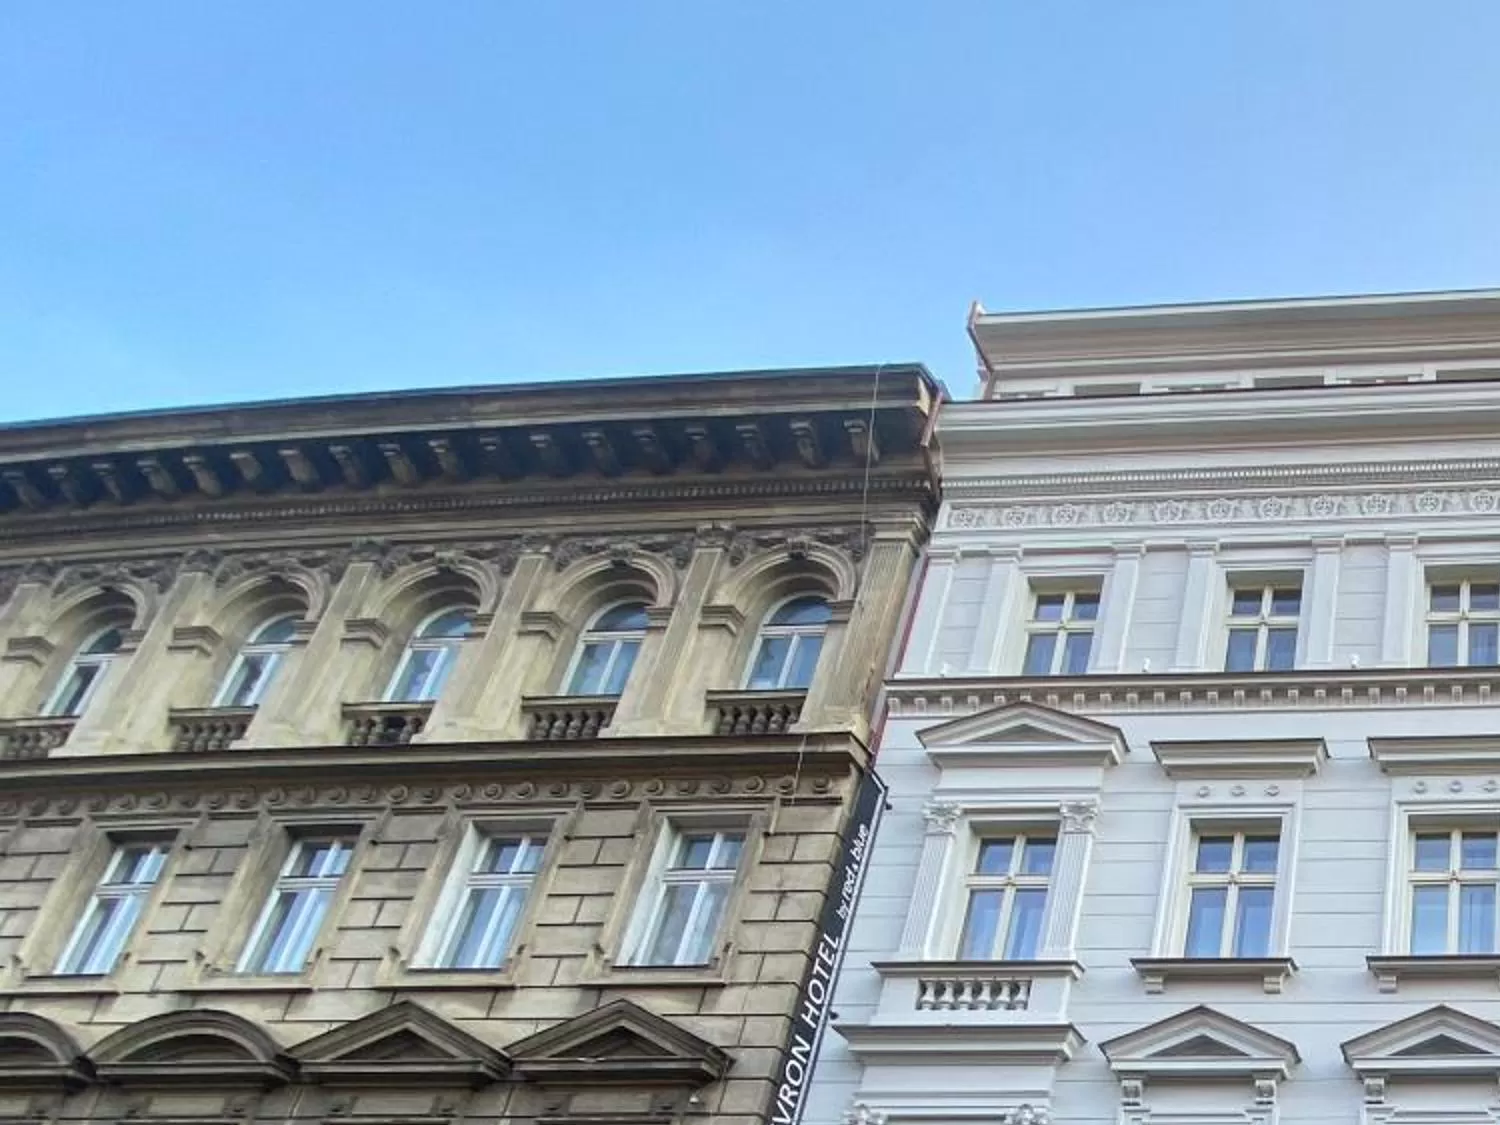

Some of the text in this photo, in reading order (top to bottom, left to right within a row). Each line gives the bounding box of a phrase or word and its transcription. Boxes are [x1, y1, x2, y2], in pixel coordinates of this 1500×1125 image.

[801, 933, 839, 1028] HOTEL
[842, 865, 855, 900] red
[850, 823, 869, 861] blue
